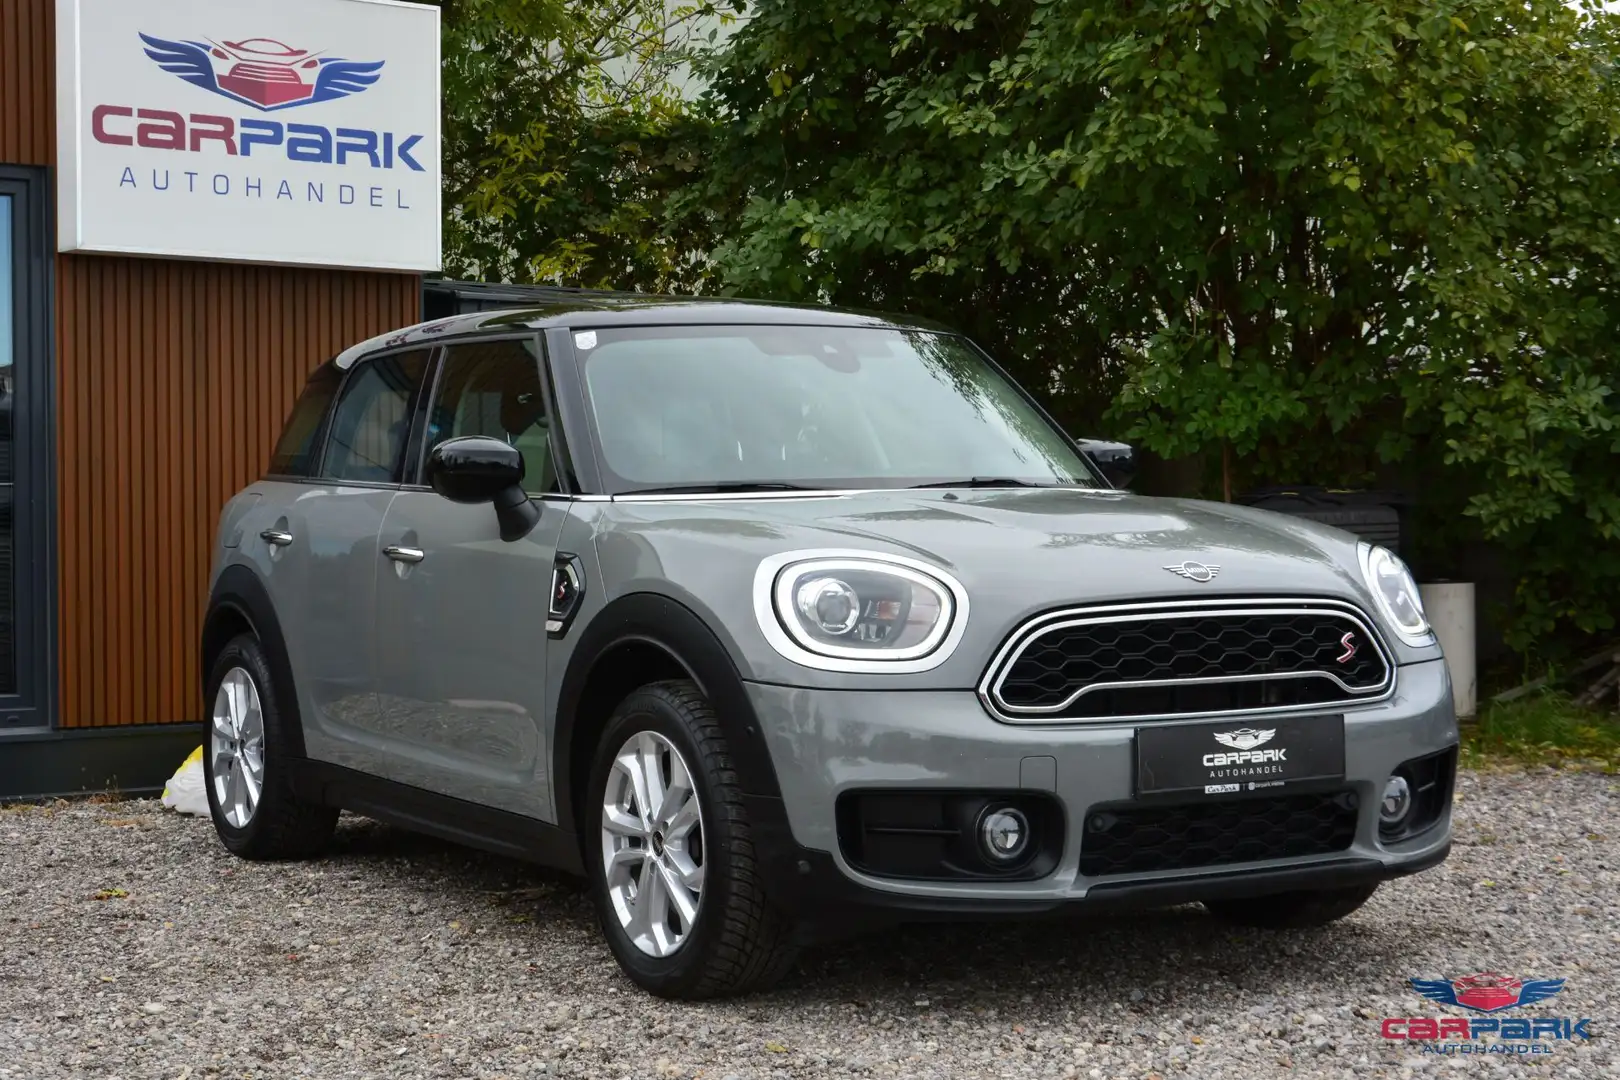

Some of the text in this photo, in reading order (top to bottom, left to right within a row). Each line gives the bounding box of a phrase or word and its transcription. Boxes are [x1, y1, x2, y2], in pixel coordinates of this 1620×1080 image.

[119, 166, 410, 209] AUTOHANDEL
[1336, 631, 1355, 663] S
[1209, 765, 1283, 778] AUTOHANDEL
